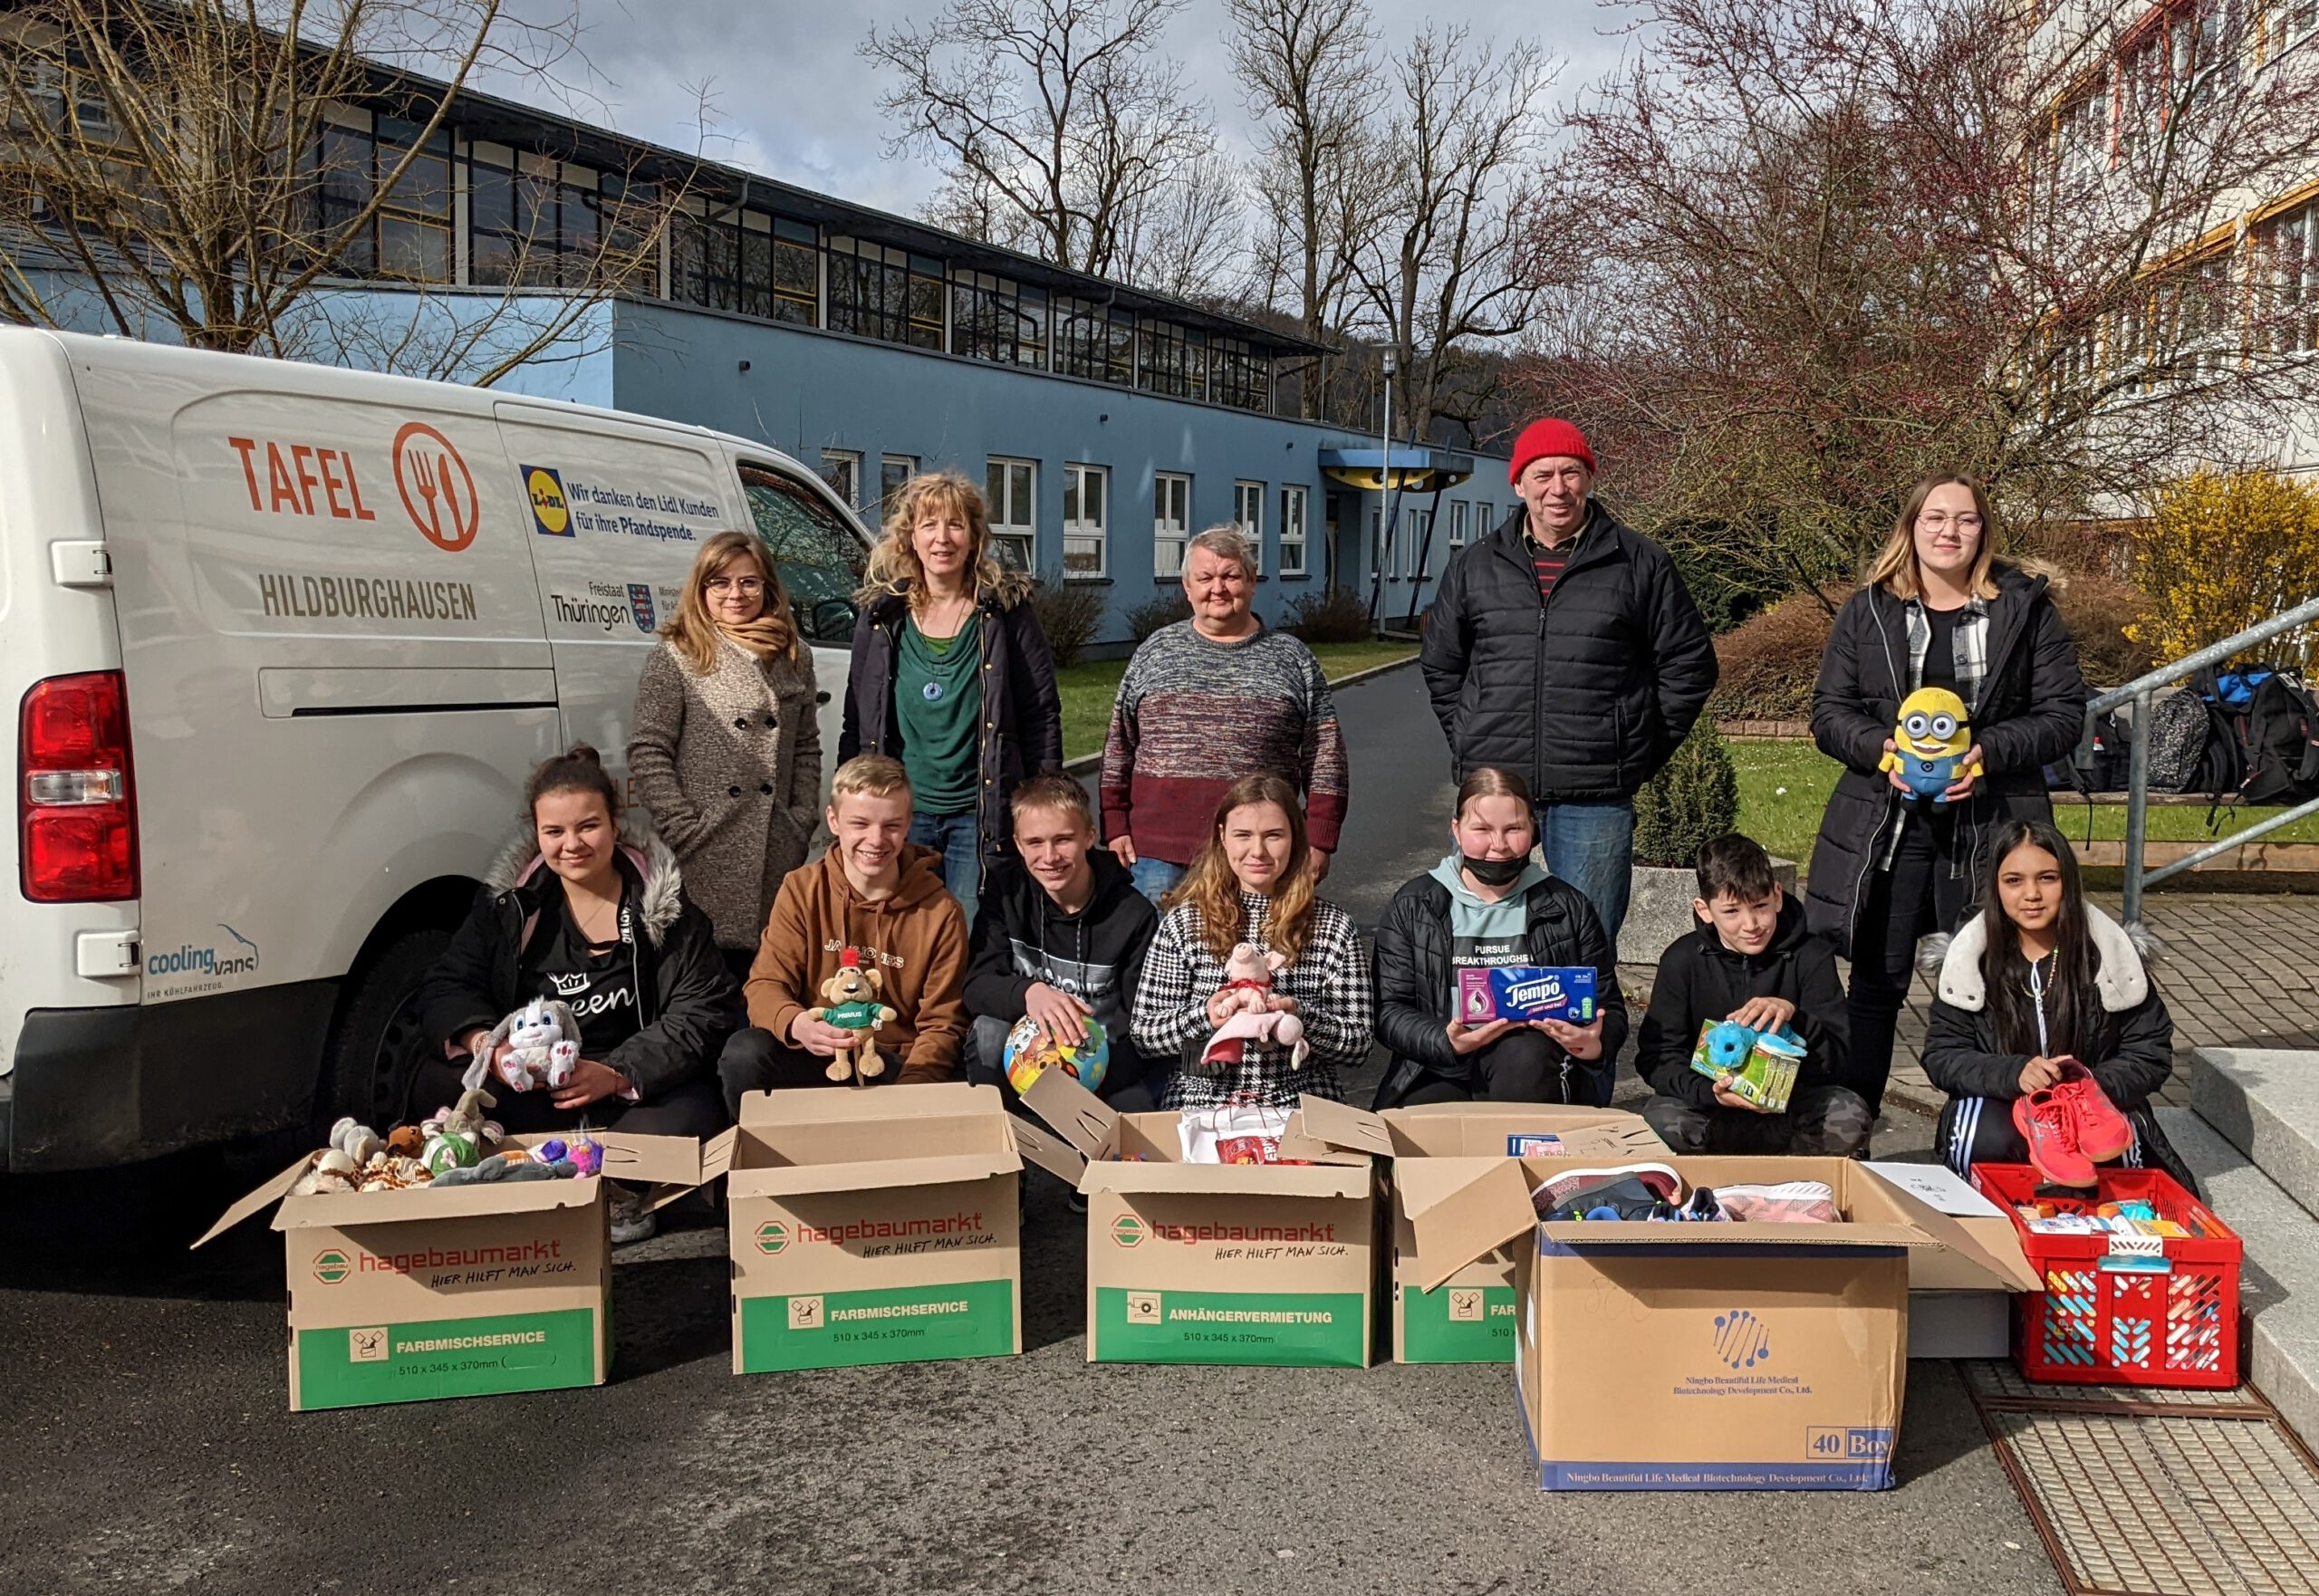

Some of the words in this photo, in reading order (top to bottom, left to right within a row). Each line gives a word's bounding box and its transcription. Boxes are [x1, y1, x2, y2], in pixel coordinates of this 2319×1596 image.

[228, 436, 376, 521] TAFEL
[567, 483, 589, 501] Wir
[592, 486, 634, 507] danken
[637, 493, 657, 510] den
[657, 495, 679, 514] Lidl
[679, 499, 719, 518] Kunden
[576, 512, 593, 530] für
[595, 514, 618, 533] ihre
[620, 517, 697, 542] Pfandspende.
[259, 574, 477, 620] HILDBURGHAUSEN
[589, 582, 625, 598] Freistaat
[551, 594, 630, 631] Thüringen
[1475, 944, 1511, 955] PURSUE
[1452, 954, 1529, 966] BREAKTHROUGHS
[147, 991, 161, 999] IHR
[164, 981, 225, 996] KÜHLFAHRZEUG.
[1506, 977, 1561, 1007] Tempo
[797, 1212, 983, 1245] hagebaumarkt
[1152, 1219, 1334, 1245] hagebaumarkt
[863, 1245, 890, 1258] HIER
[894, 1240, 932, 1255] HILFT
[934, 1236, 964, 1249] MAN
[966, 1233, 997, 1245] SICH.
[1215, 1247, 1242, 1260] HIER
[1246, 1246, 1284, 1259] HILFT
[1285, 1245, 1315, 1257] MAN
[1317, 1245, 1349, 1255] SICH.
[359, 1239, 561, 1274] hagebaumarkt
[431, 1274, 461, 1288] HIER
[465, 1268, 506, 1284] HILFT
[508, 1264, 540, 1278] MAN
[544, 1260, 577, 1273] SICH.
[831, 1301, 968, 1322] FARBMISCHSERVICE
[1169, 1308, 1333, 1324] ANHÄNGERVERMIETUNG
[396, 1330, 546, 1353] FARBMISCHSERVICE
[833, 1332, 852, 1342] 510
[861, 1331, 879, 1341] 345
[890, 1328, 925, 1339] 370mm
[1183, 1332, 1202, 1342] 510
[1211, 1332, 1229, 1342] 345
[1238, 1333, 1274, 1344] 370mm
[1492, 1329, 1509, 1337] 510
[399, 1364, 419, 1376] 510
[420, 1366, 428, 1374] x
[429, 1362, 449, 1374] 345
[460, 1359, 498, 1371] 370mm
[1686, 1376, 1714, 1386] Ningbo
[1715, 1376, 1749, 1384] Beautiful
[1750, 1376, 1766, 1384] Life
[1767, 1376, 1798, 1384] Medical
[1673, 1387, 1726, 1396] Biotechnology
[1727, 1387, 1777, 1396] Development
[1779, 1387, 1794, 1395] Co.,
[1813, 1434, 1841, 1454] 40
[1850, 1434, 1890, 1454] Box
[1566, 1473, 1600, 1485] Ningbo
[1602, 1473, 1643, 1483] Beautiful
[1645, 1473, 1663, 1483] Life
[1666, 1473, 1700, 1483] Medical
[1703, 1473, 1766, 1485] Biotechnology
[1769, 1474, 1826, 1485] Development
[1828, 1474, 1847, 1484] Co.,
